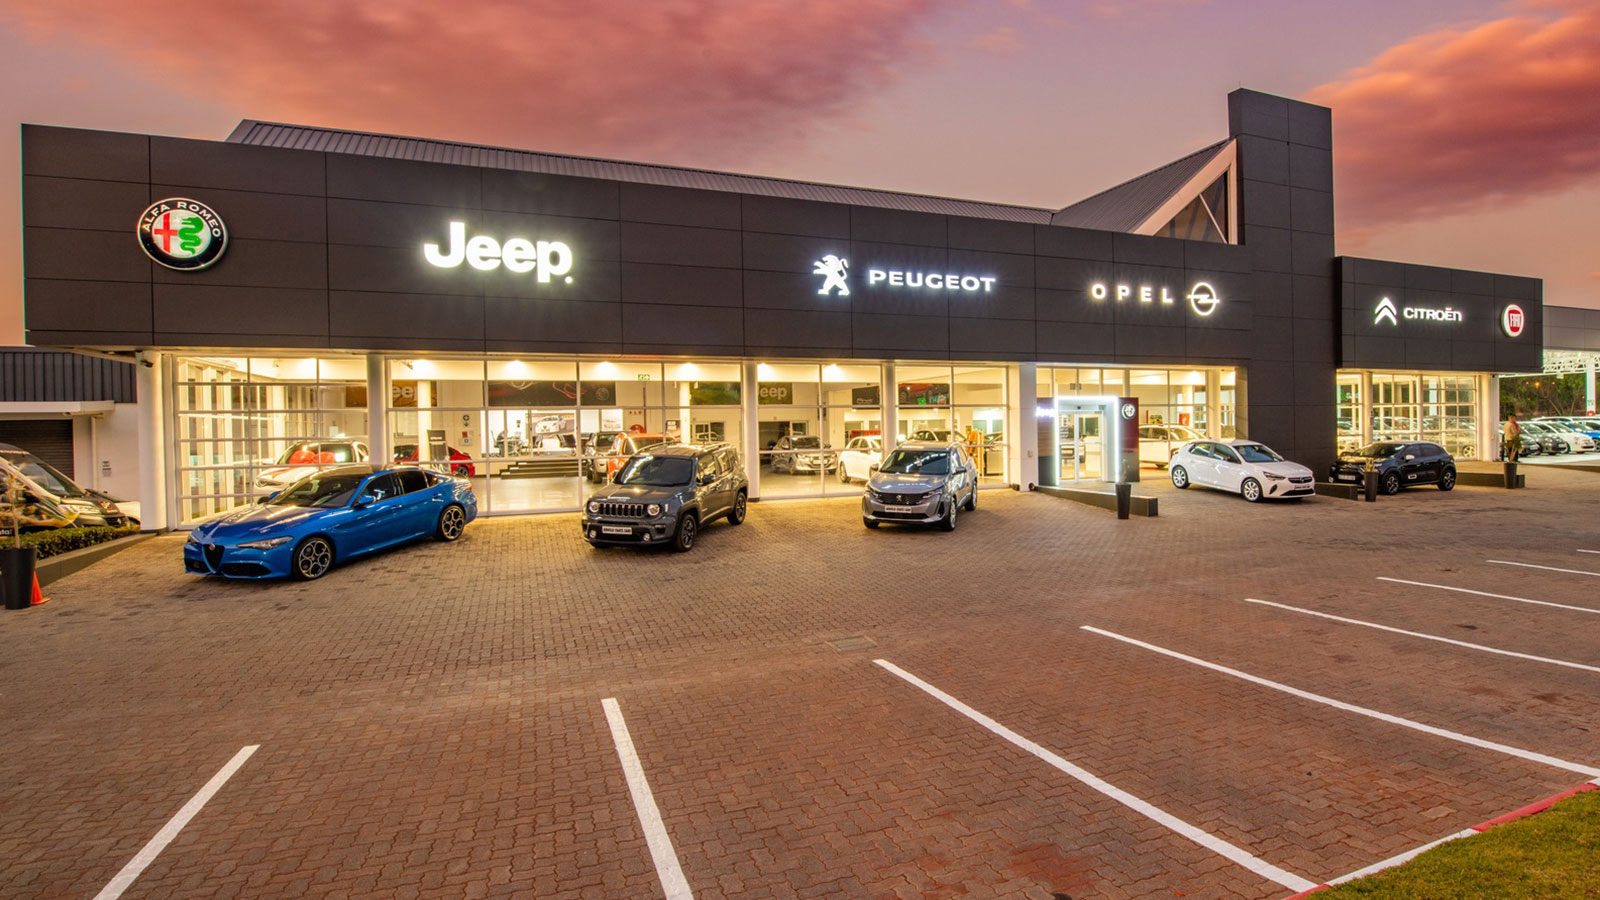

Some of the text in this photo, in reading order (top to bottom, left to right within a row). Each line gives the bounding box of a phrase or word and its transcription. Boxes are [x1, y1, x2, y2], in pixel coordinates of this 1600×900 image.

[141, 201, 221, 237] ALFA ROMEO
[423, 221, 573, 284] Jeep
[868, 268, 997, 293] PEUGEOT
[1091, 282, 1174, 305] OPEL
[1510, 313, 1522, 328] FIAT
